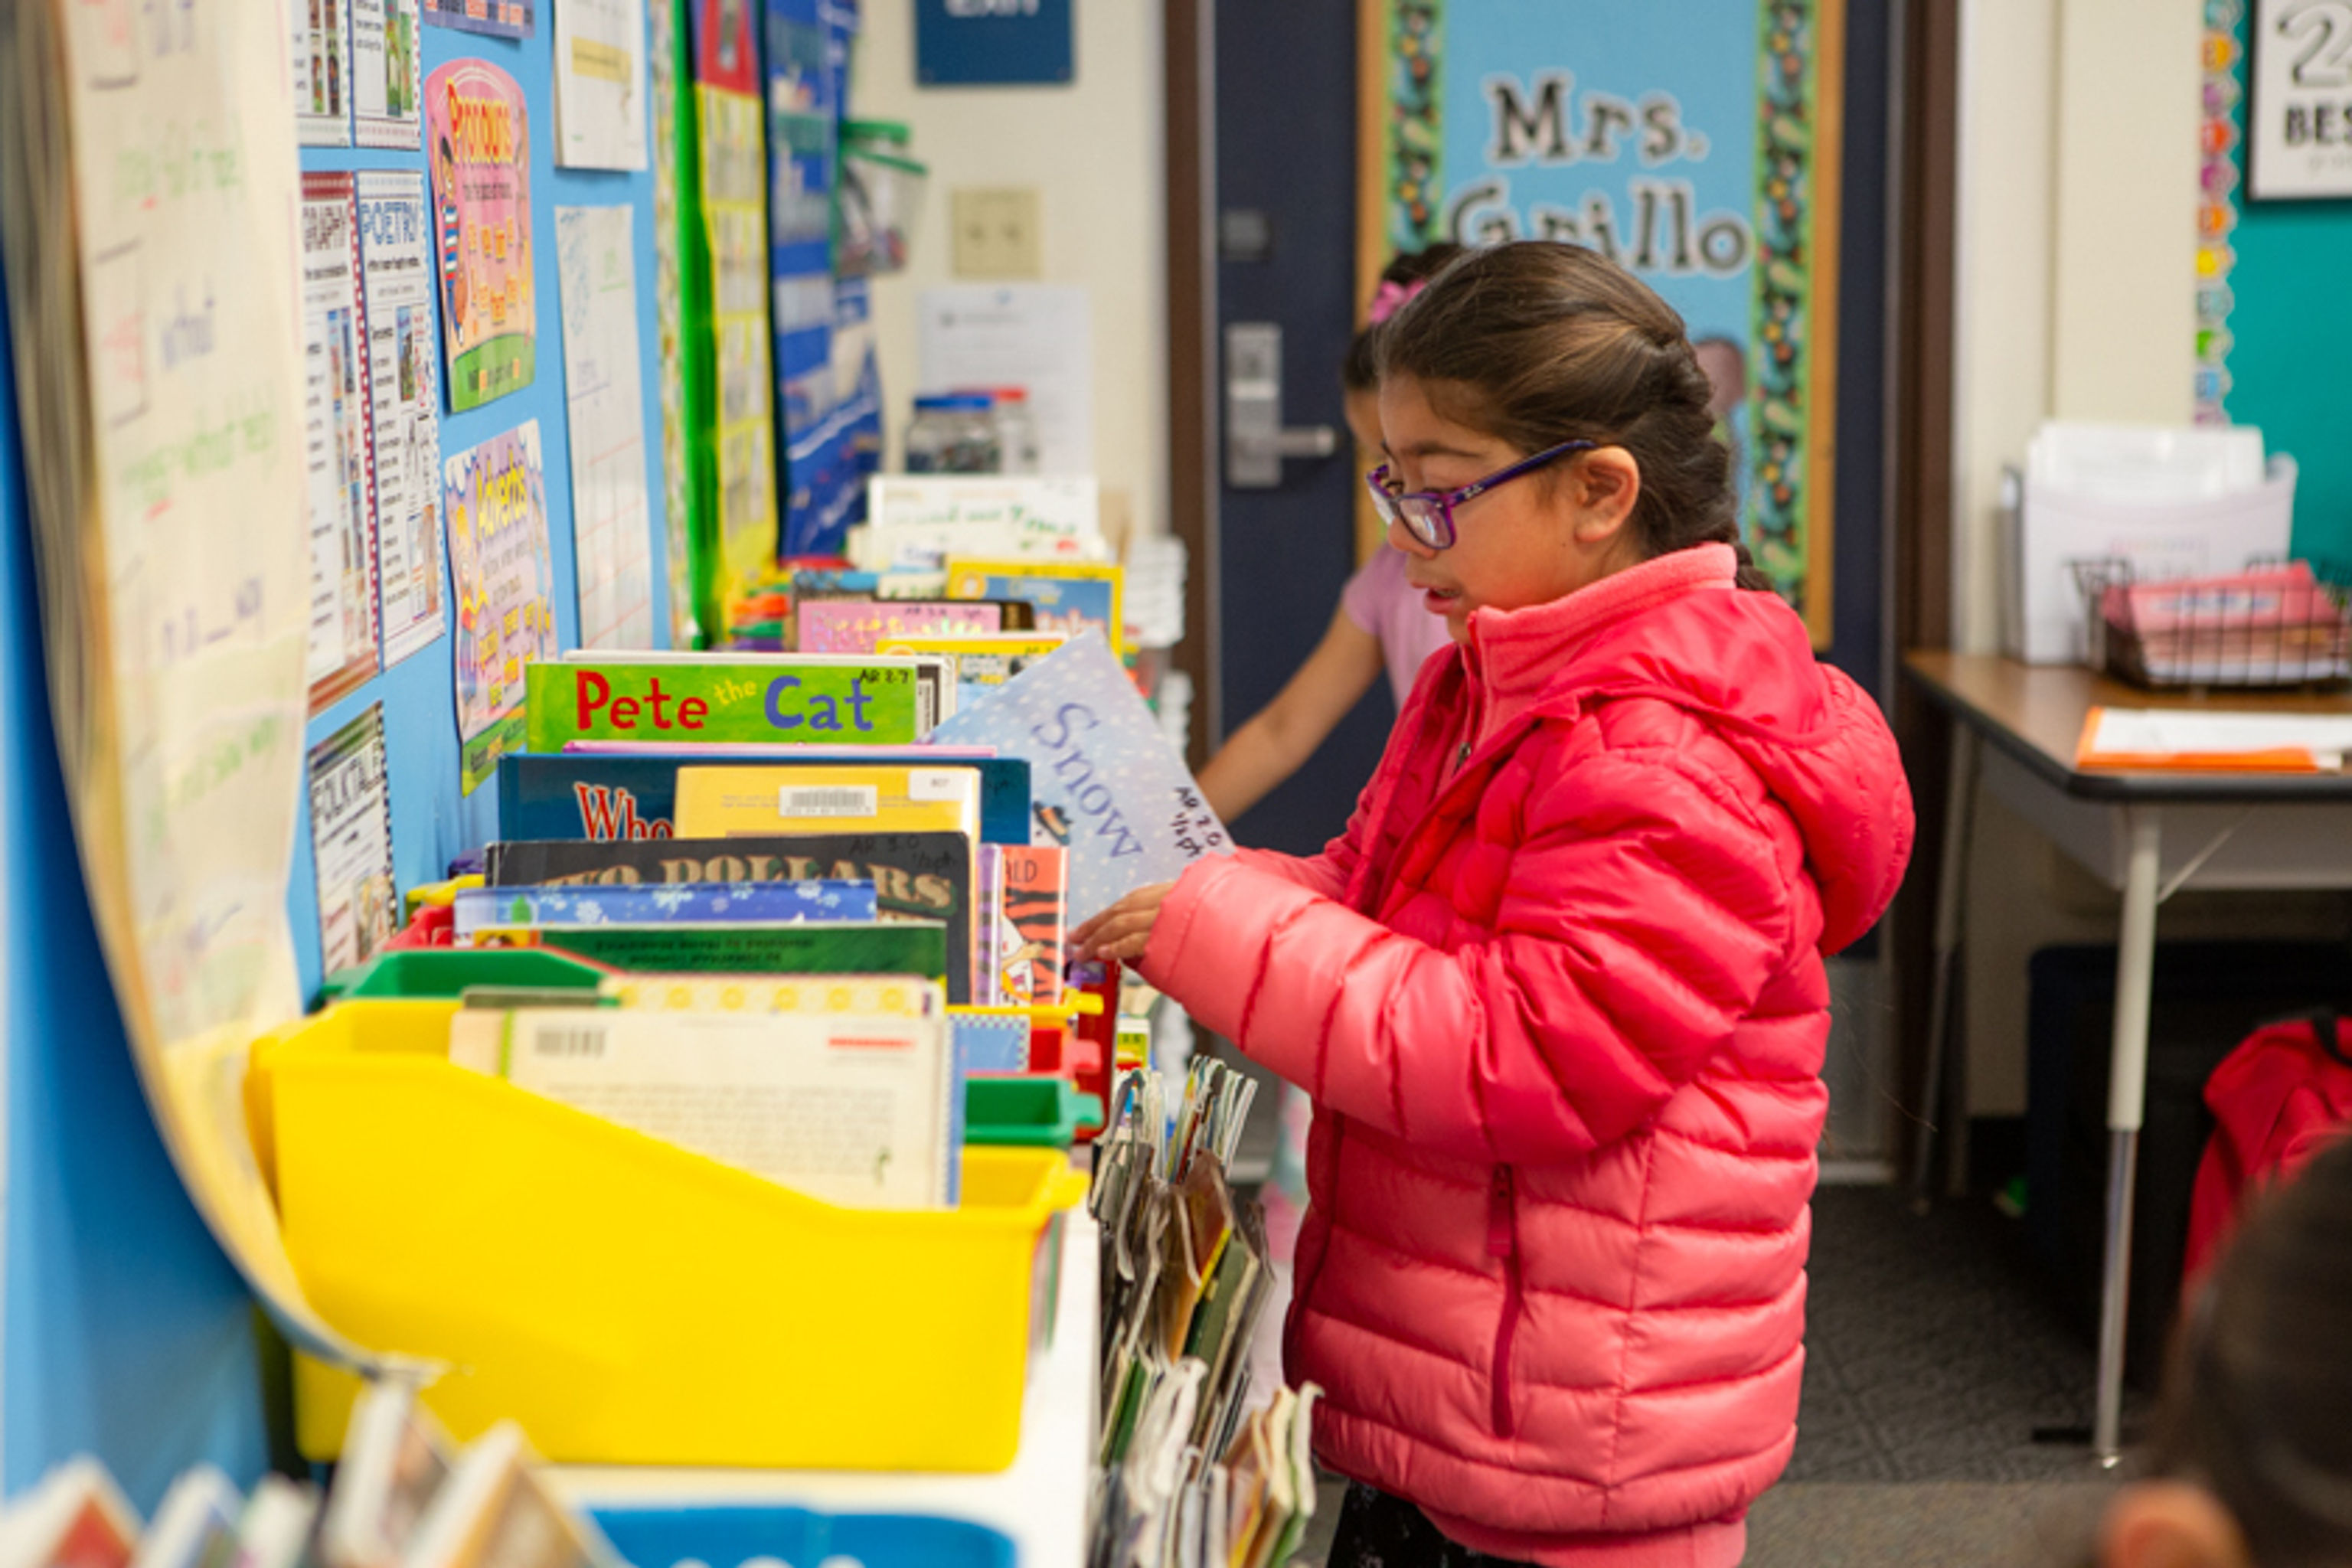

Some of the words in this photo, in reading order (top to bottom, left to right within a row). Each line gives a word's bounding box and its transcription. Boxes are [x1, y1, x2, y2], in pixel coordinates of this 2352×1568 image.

[1487, 70, 1710, 164] Mrs.
[577, 670, 708, 730] Pete
[714, 678, 756, 706] the
[764, 675, 874, 730] Cat
[573, 781, 673, 841] Who
[1031, 702, 1144, 859] Snow
